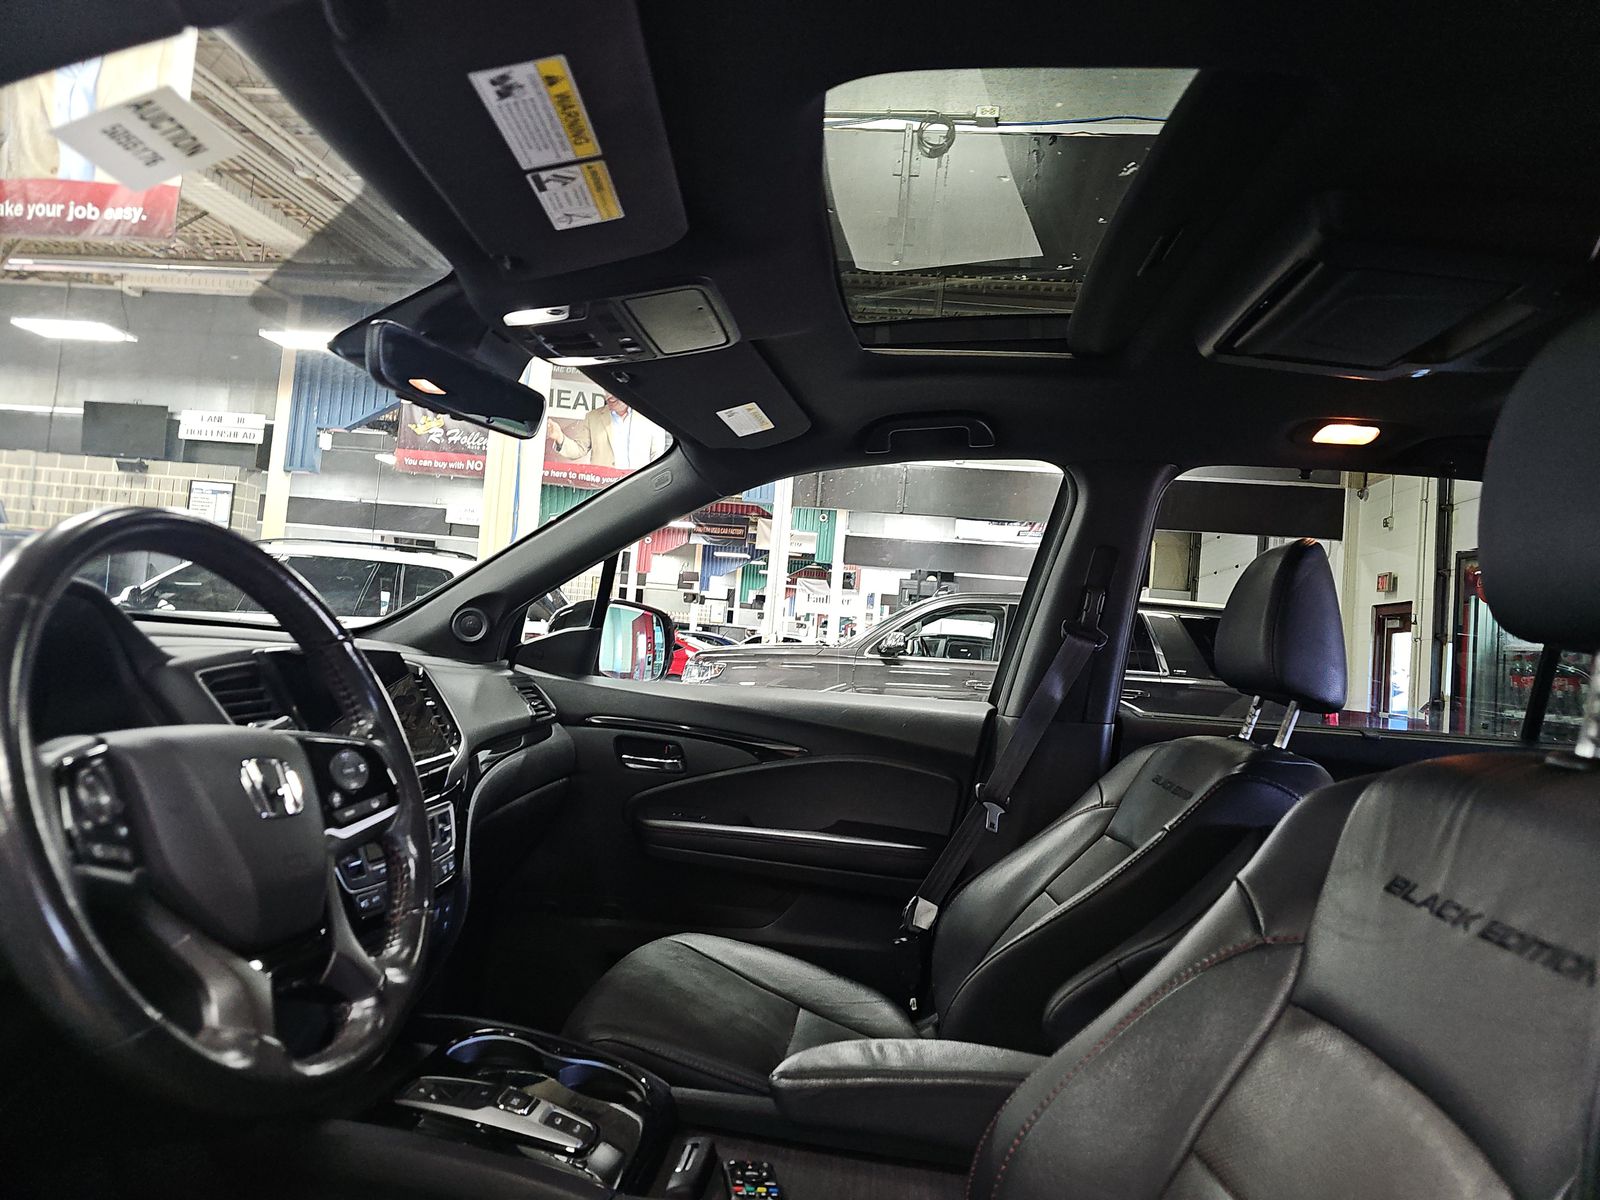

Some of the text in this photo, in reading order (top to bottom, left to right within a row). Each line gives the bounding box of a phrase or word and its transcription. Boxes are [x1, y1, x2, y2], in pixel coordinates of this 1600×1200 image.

[0, 199, 147, 224] ake your job easy.
[404, 457, 483, 471] You can buy with NO
[550, 469, 568, 478] here
[568, 471, 577, 479] to
[578, 473, 601, 483] make
[1383, 874, 1486, 932] BLACK
